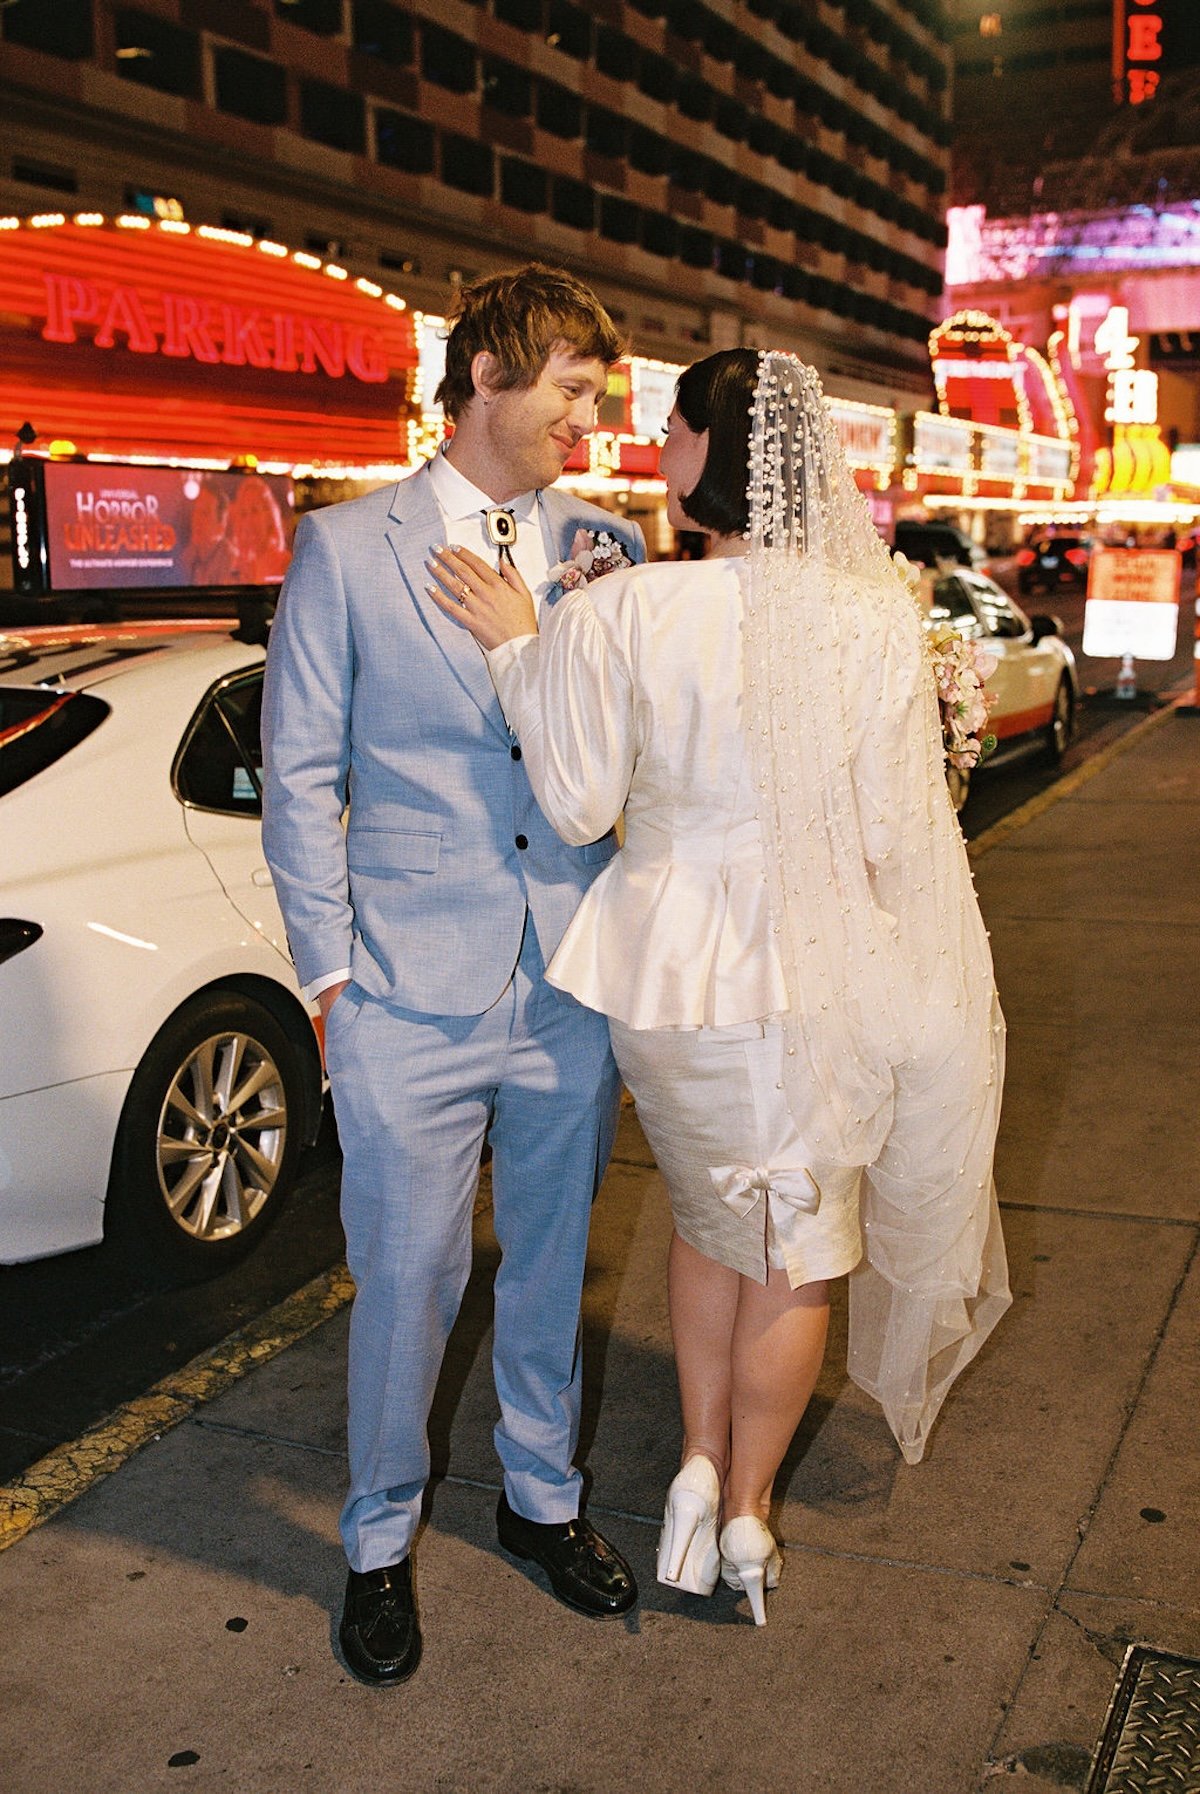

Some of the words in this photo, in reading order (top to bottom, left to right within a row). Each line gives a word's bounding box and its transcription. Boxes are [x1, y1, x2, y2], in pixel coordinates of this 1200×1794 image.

[42, 272, 389, 383] PARKING
[76, 491, 159, 523] HORROR
[64, 522, 177, 552] UNLEASHED
